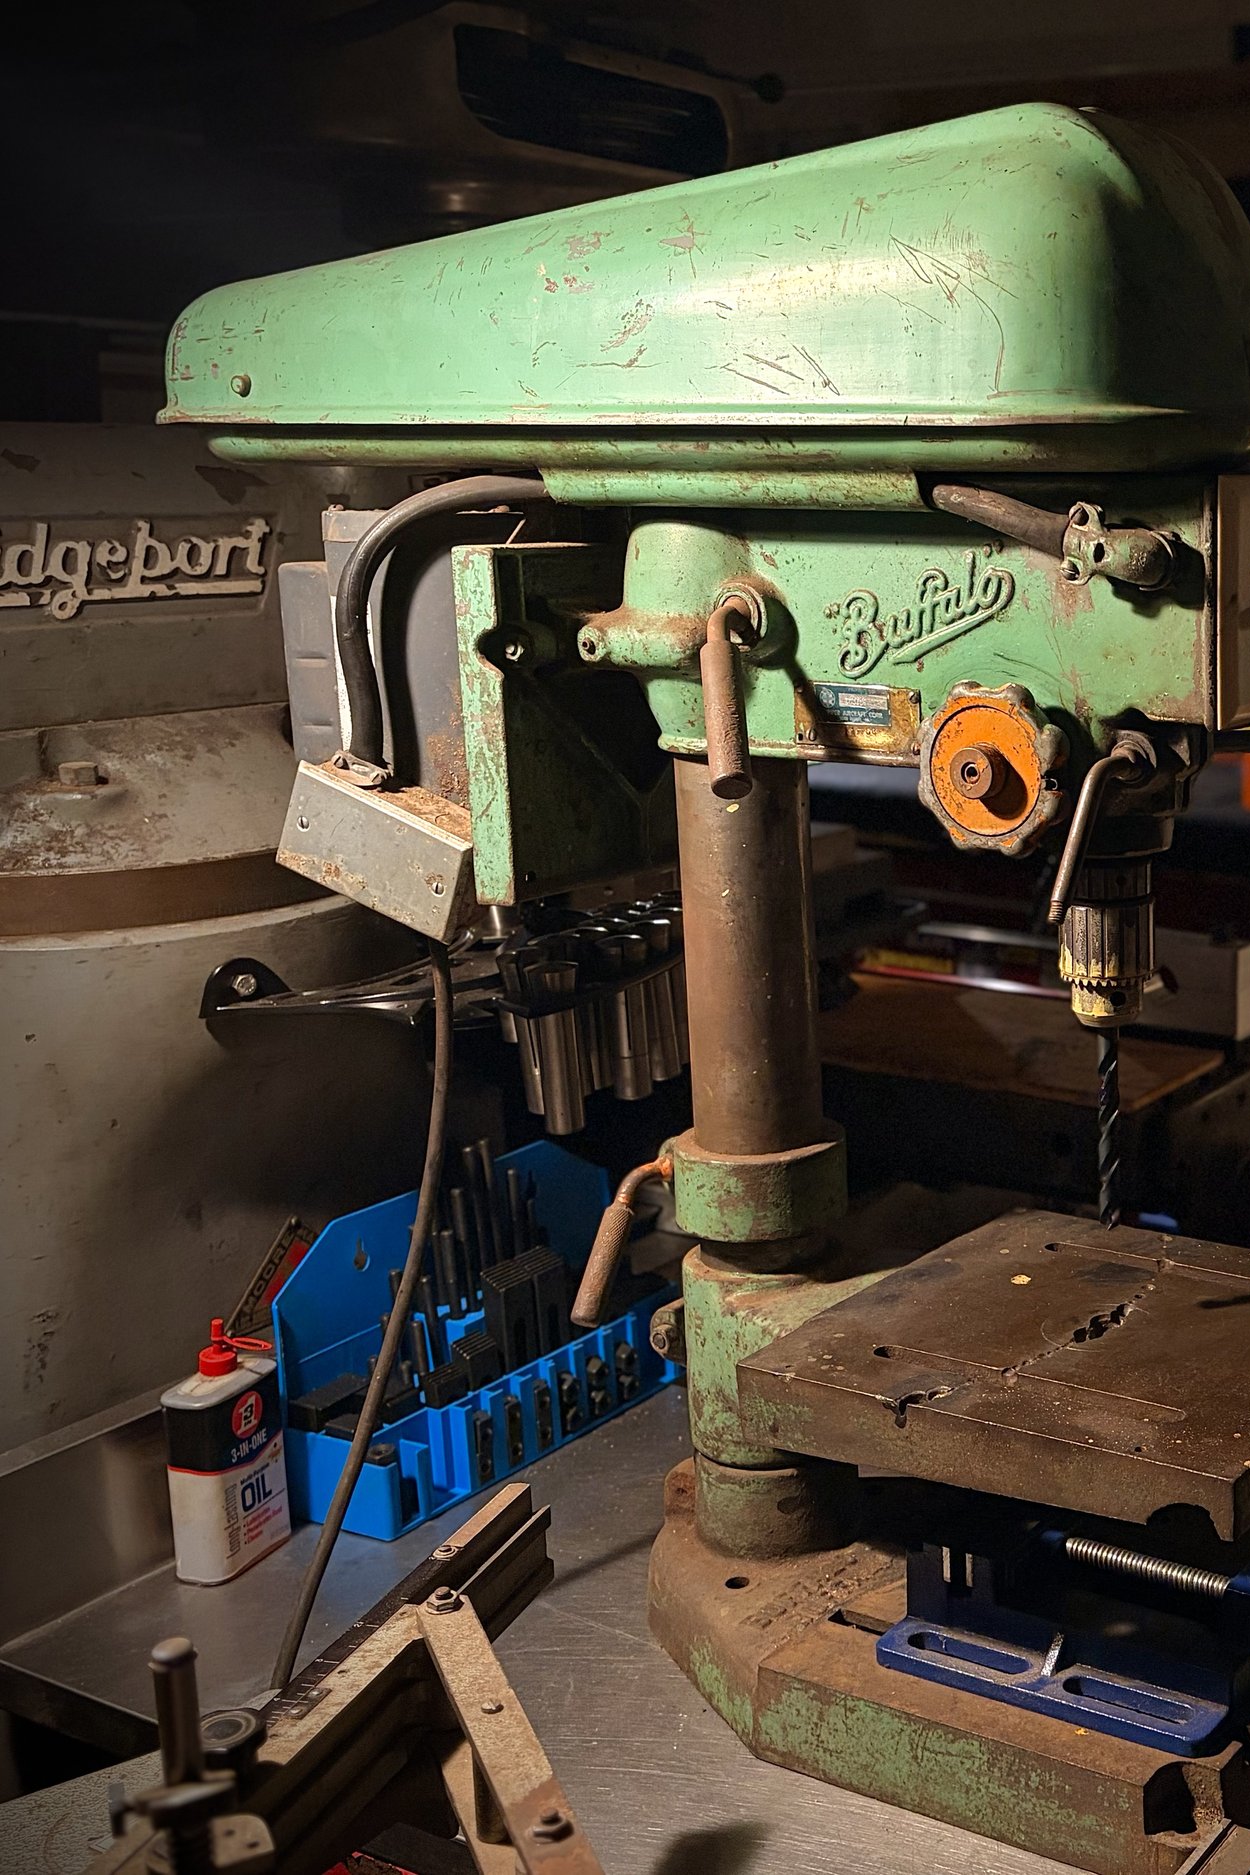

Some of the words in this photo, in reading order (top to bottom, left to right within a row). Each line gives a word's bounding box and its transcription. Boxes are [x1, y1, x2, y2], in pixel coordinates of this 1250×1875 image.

[0, 518, 271, 620] dgeport
[838, 551, 1016, 679] Buffalo
[231, 1427, 268, 1463] 3-IN-ONE
[241, 1473, 273, 1512] OIL
